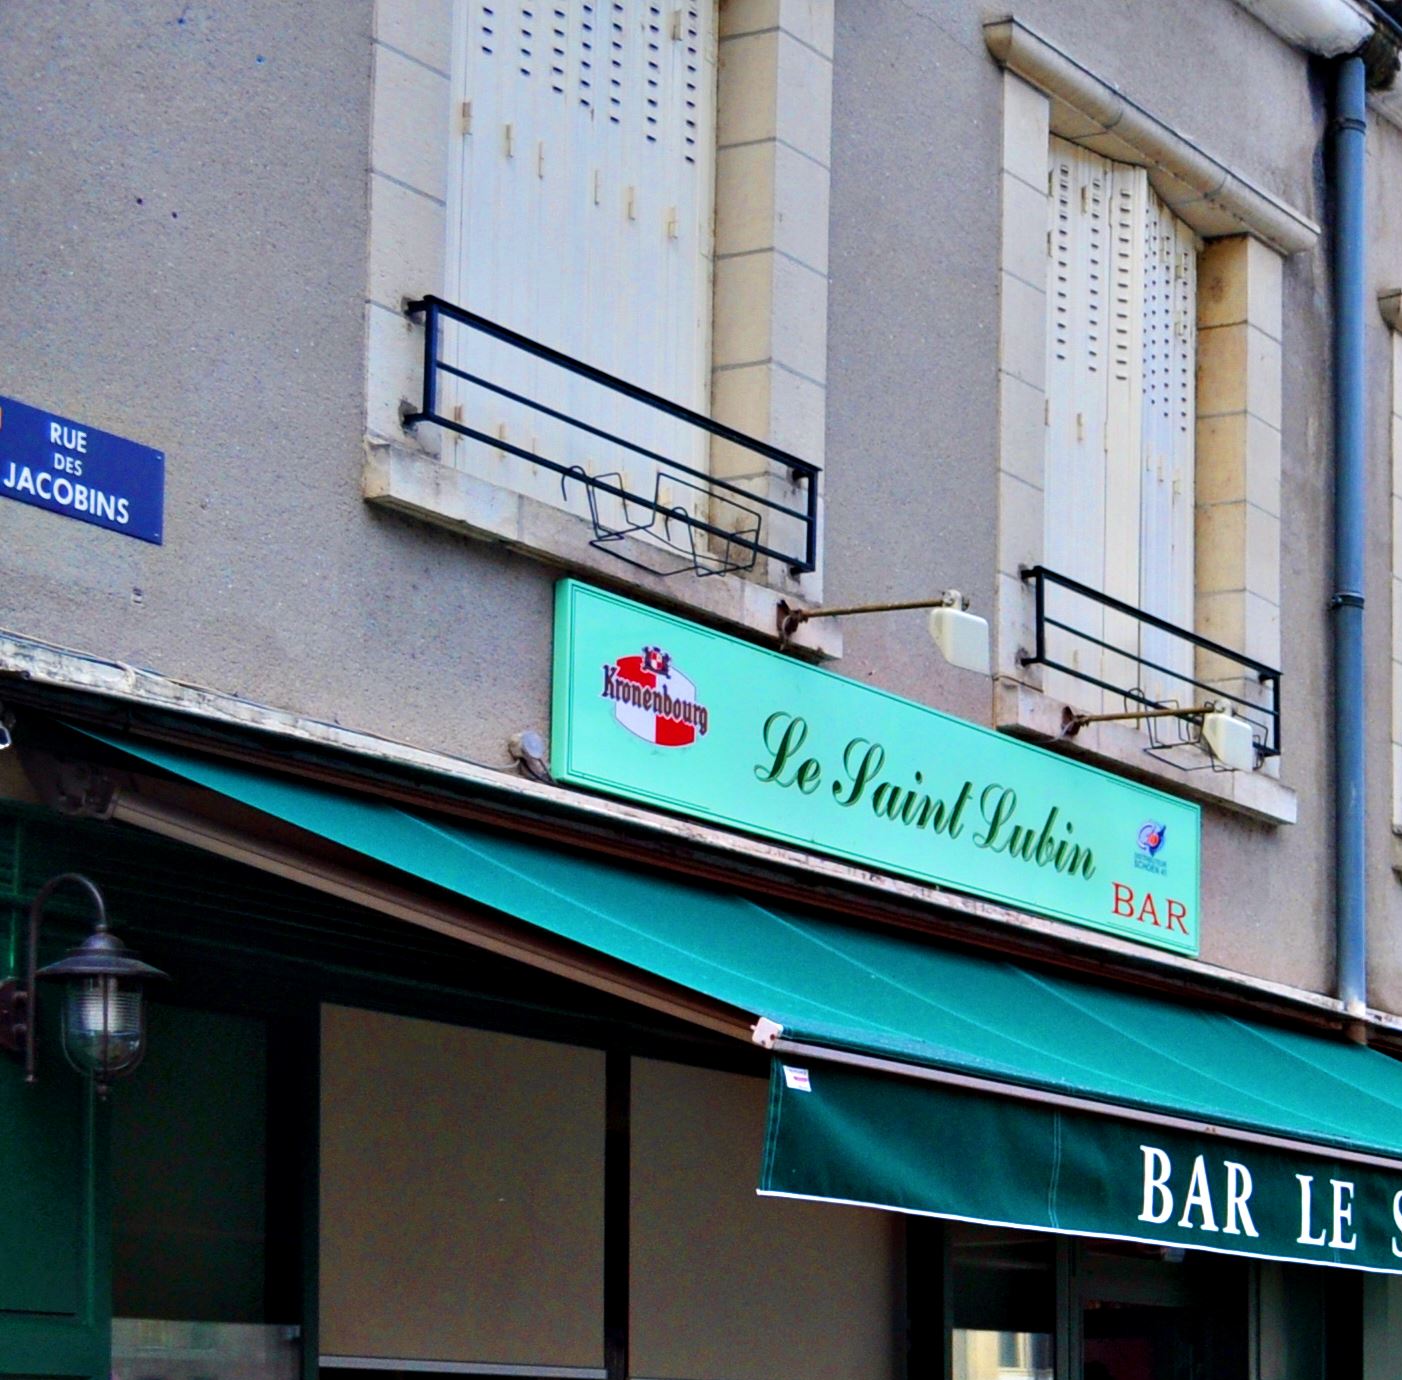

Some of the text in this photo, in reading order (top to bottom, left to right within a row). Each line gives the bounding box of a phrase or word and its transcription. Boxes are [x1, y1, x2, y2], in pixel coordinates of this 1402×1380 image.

[50, 422, 88, 454] RUE
[54, 452, 83, 477] DES
[3, 462, 130, 525] JACOBINS
[602, 664, 709, 736] Kronenbourg
[754, 711, 1096, 880] Le Saint Lubin
[1111, 882, 1190, 934] BAR
[1137, 1144, 1259, 1238] BAR
[1295, 1173, 1358, 1251] LE
